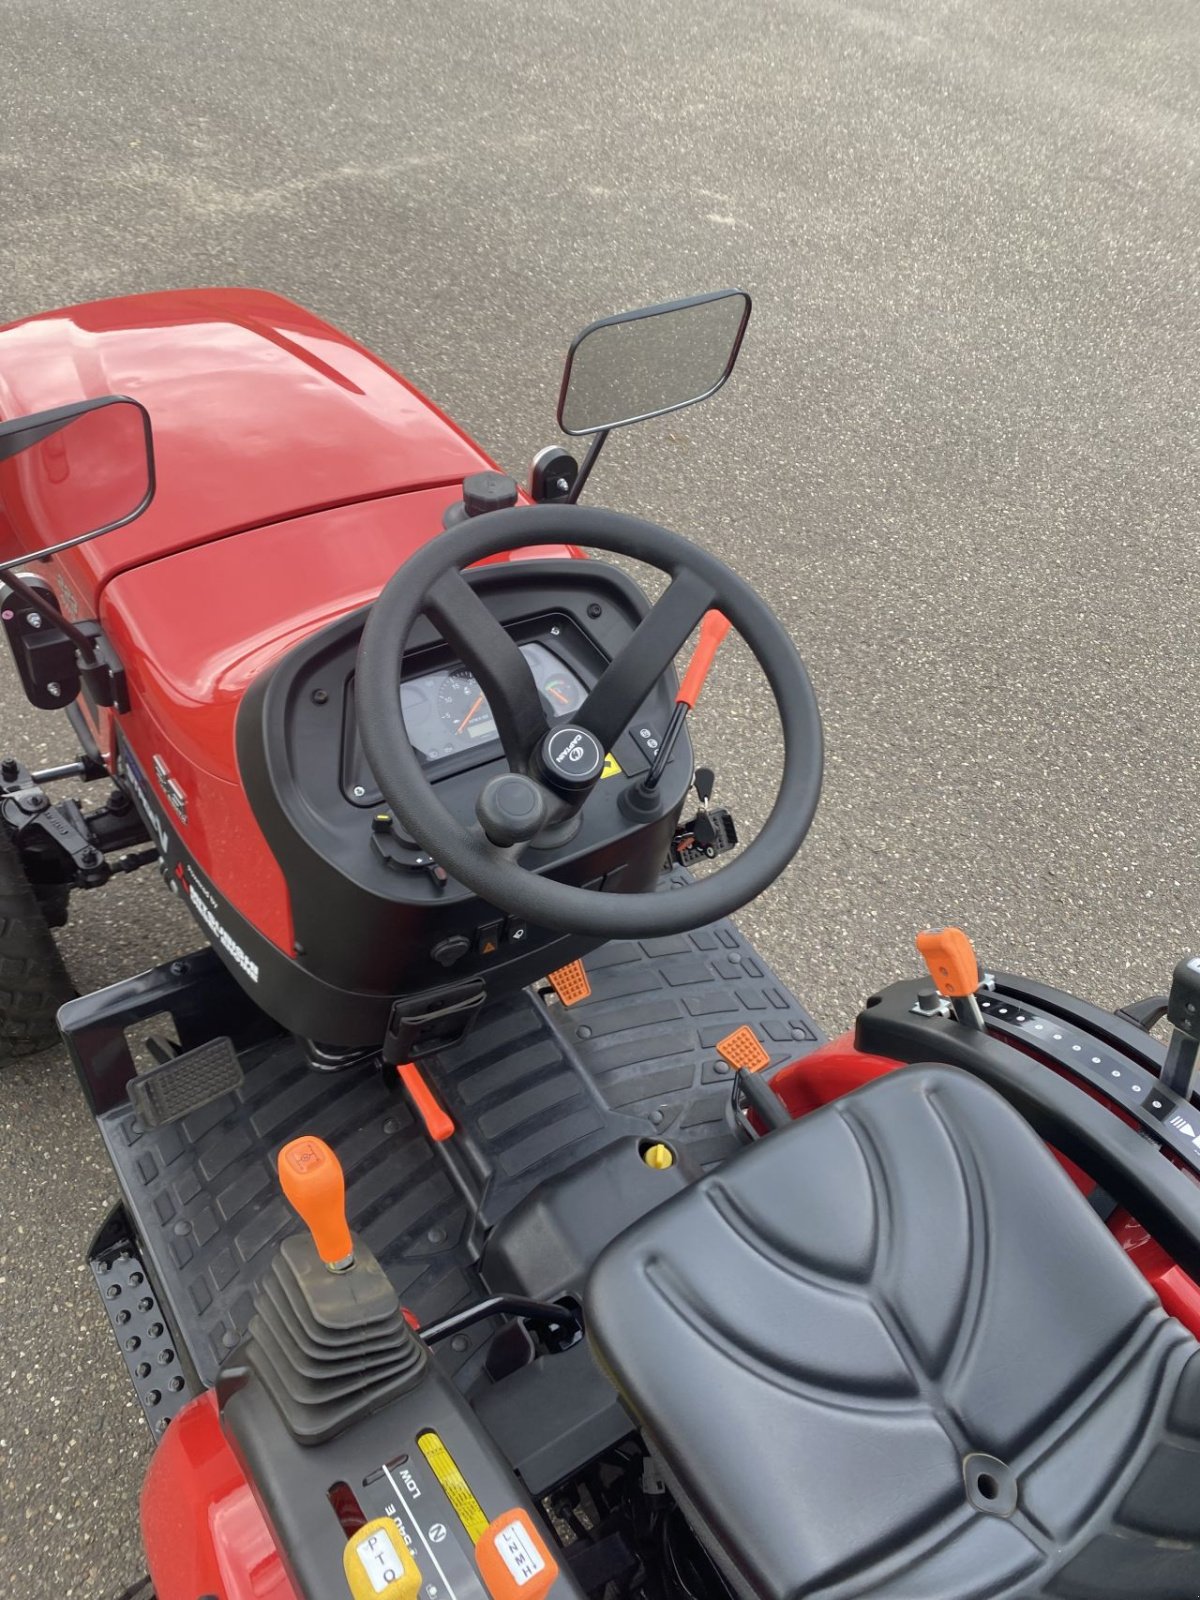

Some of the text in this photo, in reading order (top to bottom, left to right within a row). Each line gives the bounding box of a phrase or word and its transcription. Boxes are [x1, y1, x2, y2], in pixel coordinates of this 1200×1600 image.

[556, 734, 582, 763] CAPTAIN
[399, 1469, 421, 1499] LOW
[384, 1503, 396, 1517] E
[368, 1536, 396, 1584] PTO
